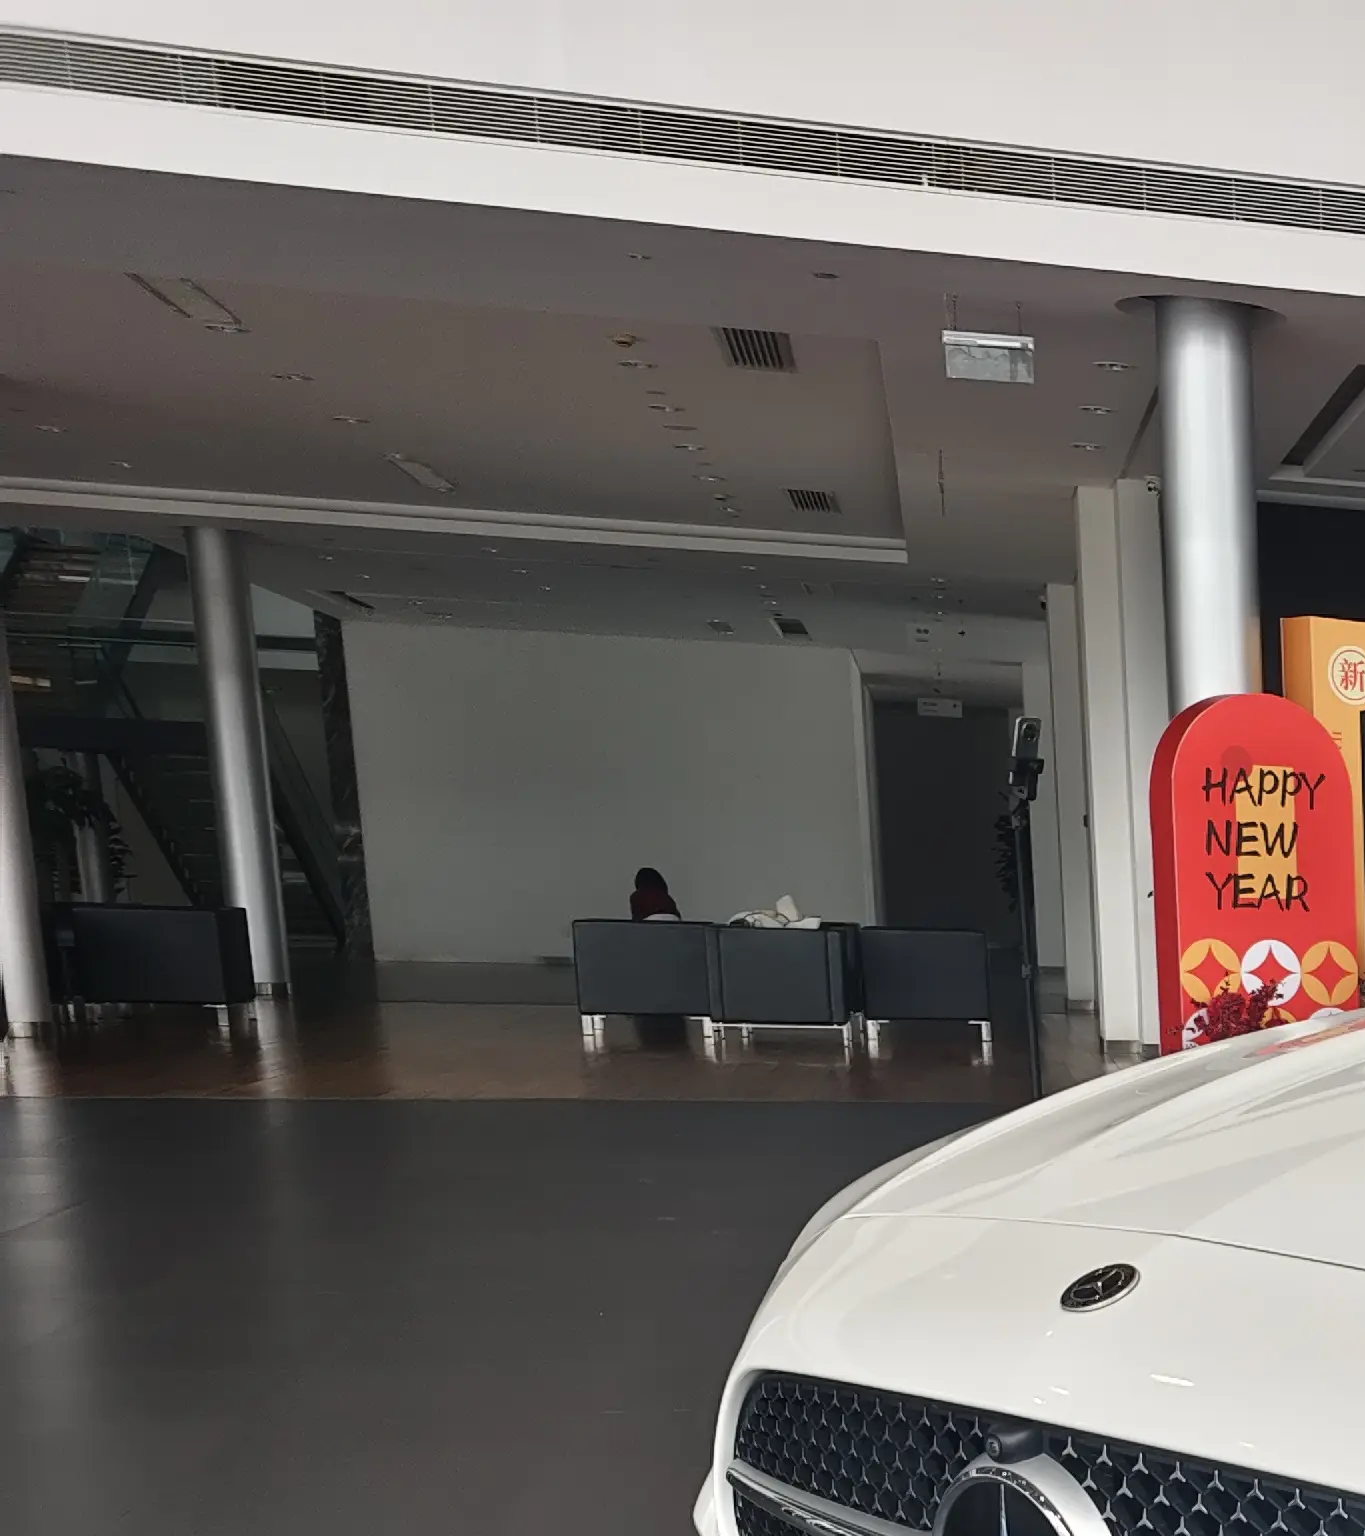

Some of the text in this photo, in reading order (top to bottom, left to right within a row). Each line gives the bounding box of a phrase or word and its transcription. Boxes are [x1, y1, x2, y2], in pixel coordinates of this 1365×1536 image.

[1202, 767, 1326, 811] HAPPY
[1205, 819, 1299, 859] NEW
[1205, 872, 1311, 912] YEAR
